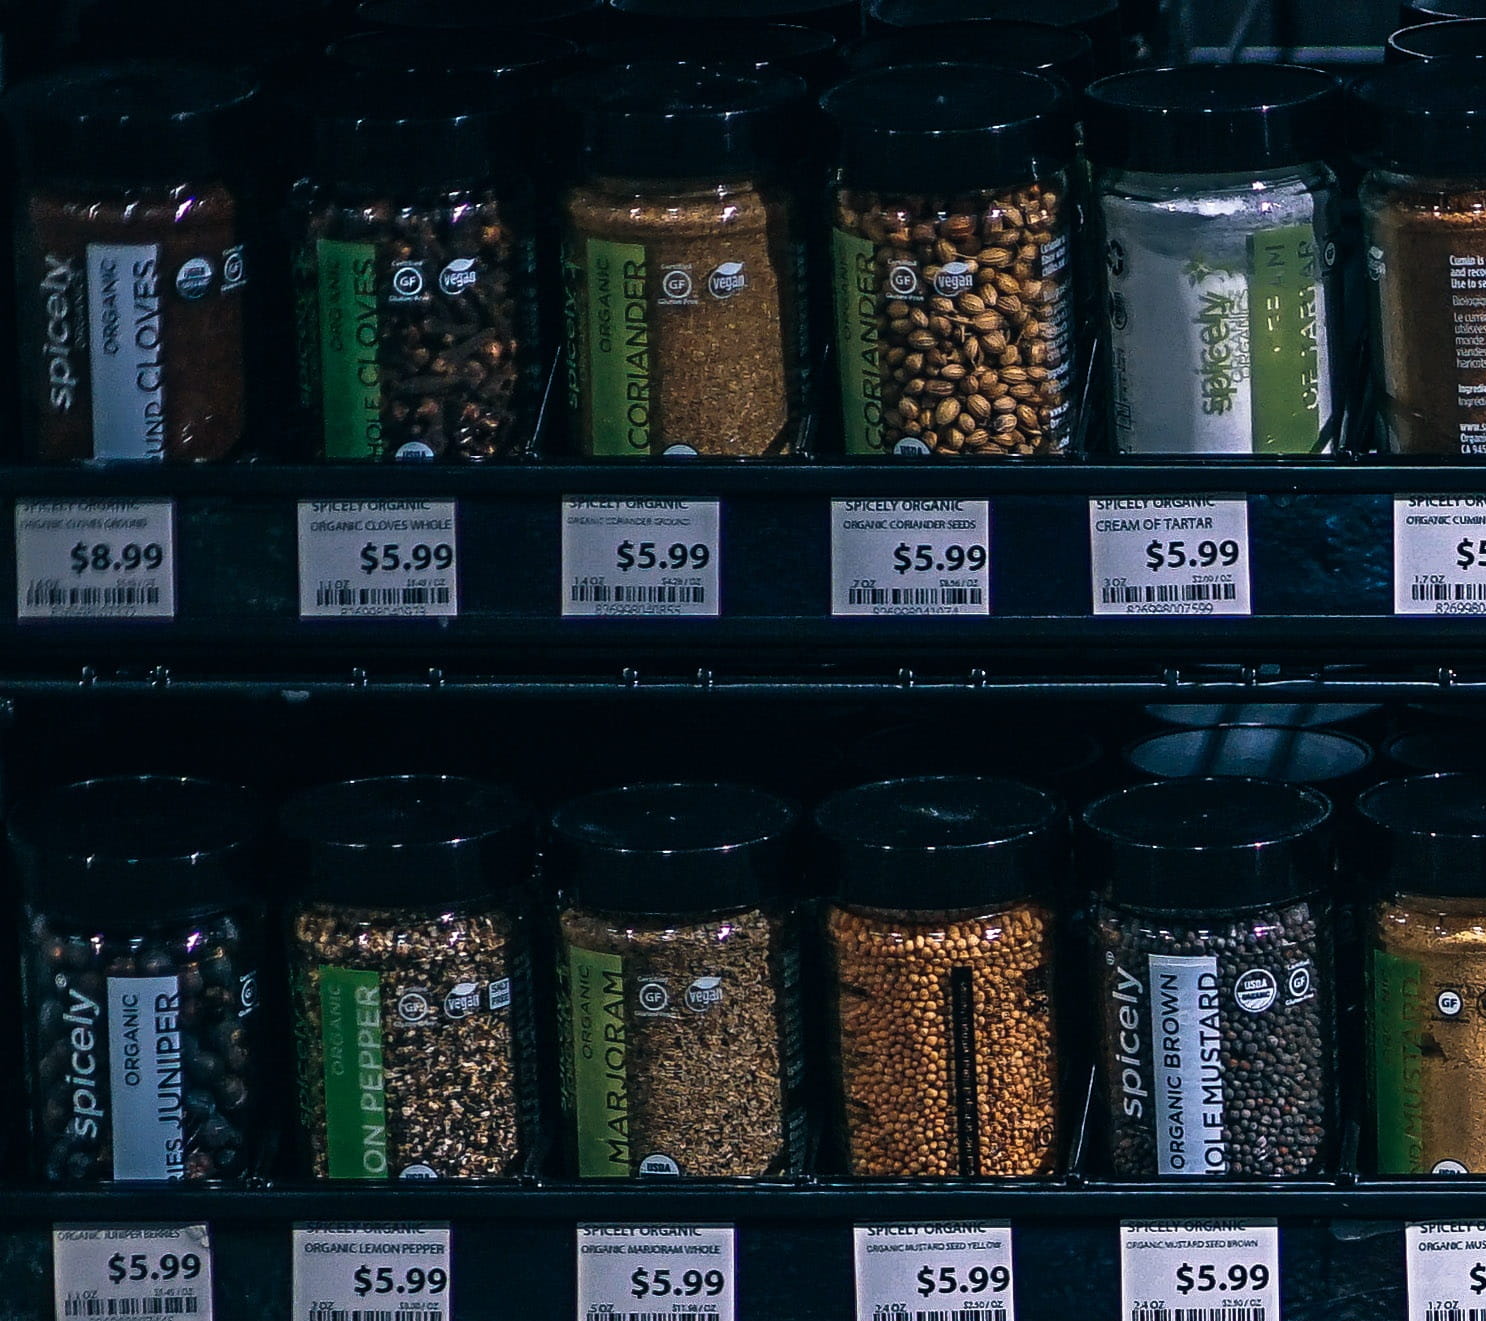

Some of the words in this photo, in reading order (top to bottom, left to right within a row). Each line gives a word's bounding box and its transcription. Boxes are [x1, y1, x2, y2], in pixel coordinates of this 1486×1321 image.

[625, 259, 649, 449] CORIANDER
[71, 542, 163, 577] $8.99
[1147, 540, 1238, 572] $5.99
[73, 984, 101, 1140] spicely
[125, 992, 139, 1086] ORGANIC
[604, 969, 629, 1165] MARJORAM
[1159, 973, 1181, 1068] BROWN
[1169, 1074, 1185, 1170] ORGANIC
[354, 1265, 447, 1297] $5.99
